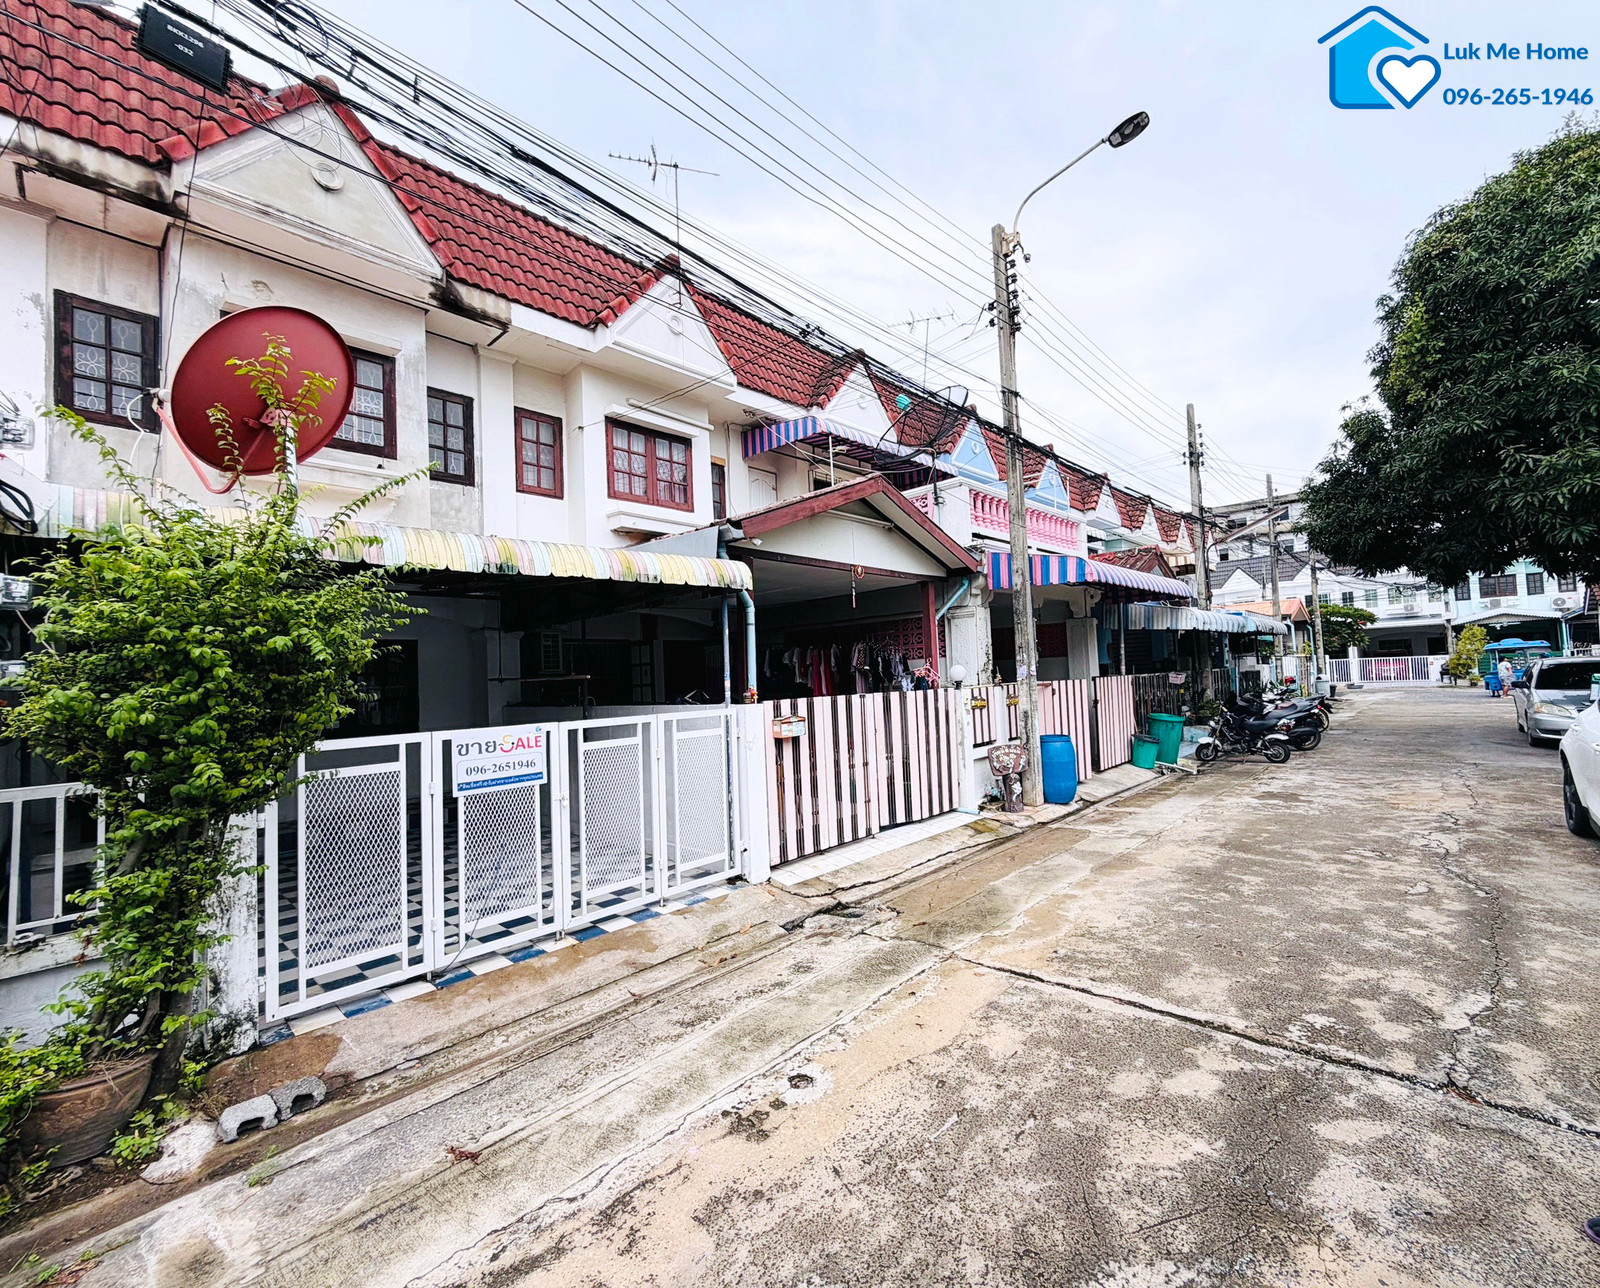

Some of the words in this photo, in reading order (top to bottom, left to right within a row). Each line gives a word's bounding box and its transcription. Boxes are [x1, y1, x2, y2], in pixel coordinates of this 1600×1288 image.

[174, 43, 194, 57] -032
[456, 740, 497, 757] ขาย
[499, 734, 542, 753] SALE
[465, 758, 536, 777] 096-2651946
